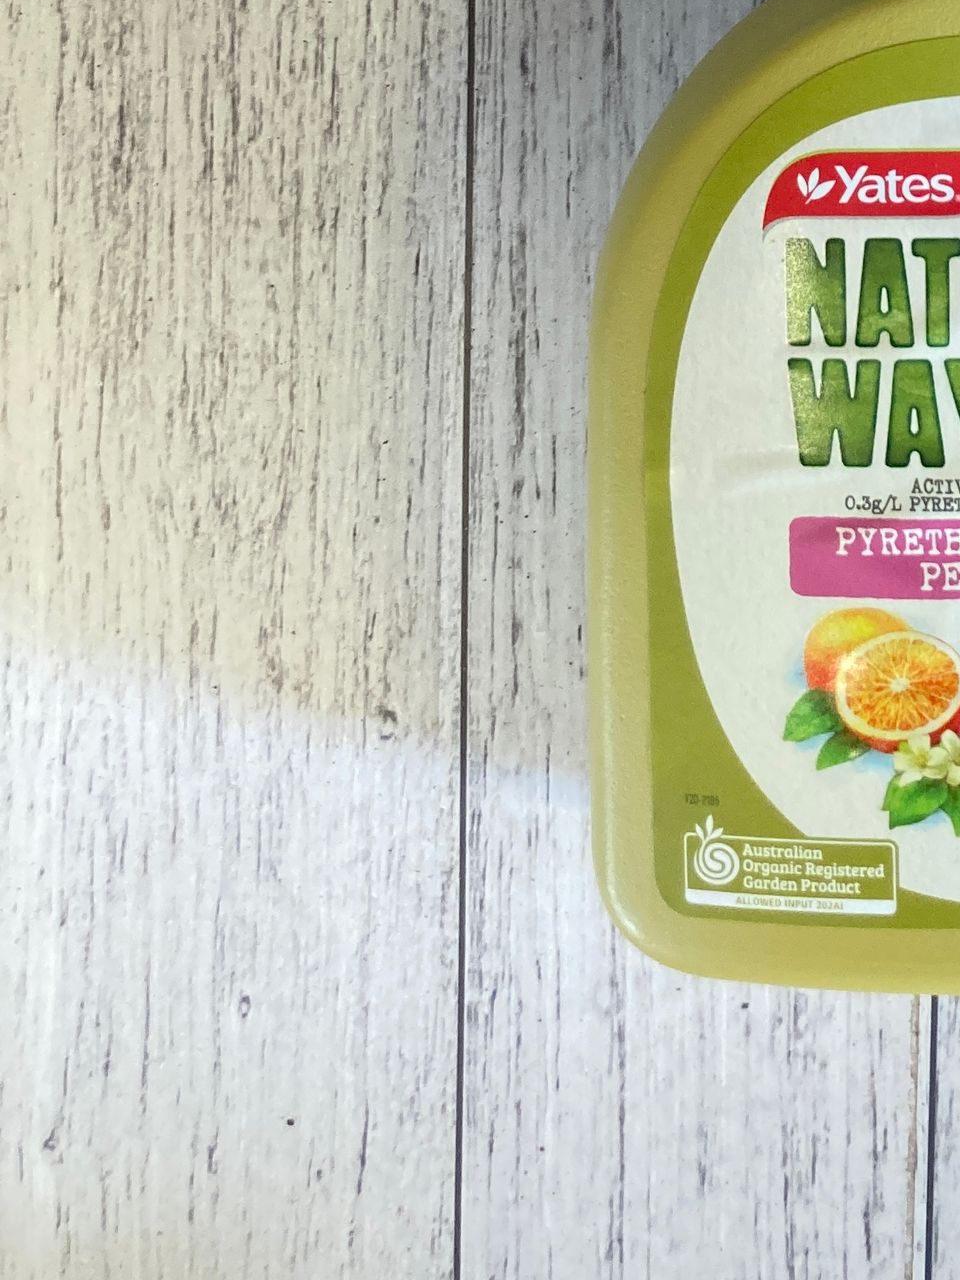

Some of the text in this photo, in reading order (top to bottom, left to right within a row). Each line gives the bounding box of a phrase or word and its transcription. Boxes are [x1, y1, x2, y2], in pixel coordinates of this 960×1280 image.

[835, 165, 955, 204] Yates
[844, 494, 902, 514] 0.3g/L
[742, 843, 823, 860] Australian
[743, 859, 885, 879] Organic Registered
[743, 876, 861, 894] Garden Product
[736, 896, 781, 907] ALLOWED
[784, 899, 813, 909] INPUT
